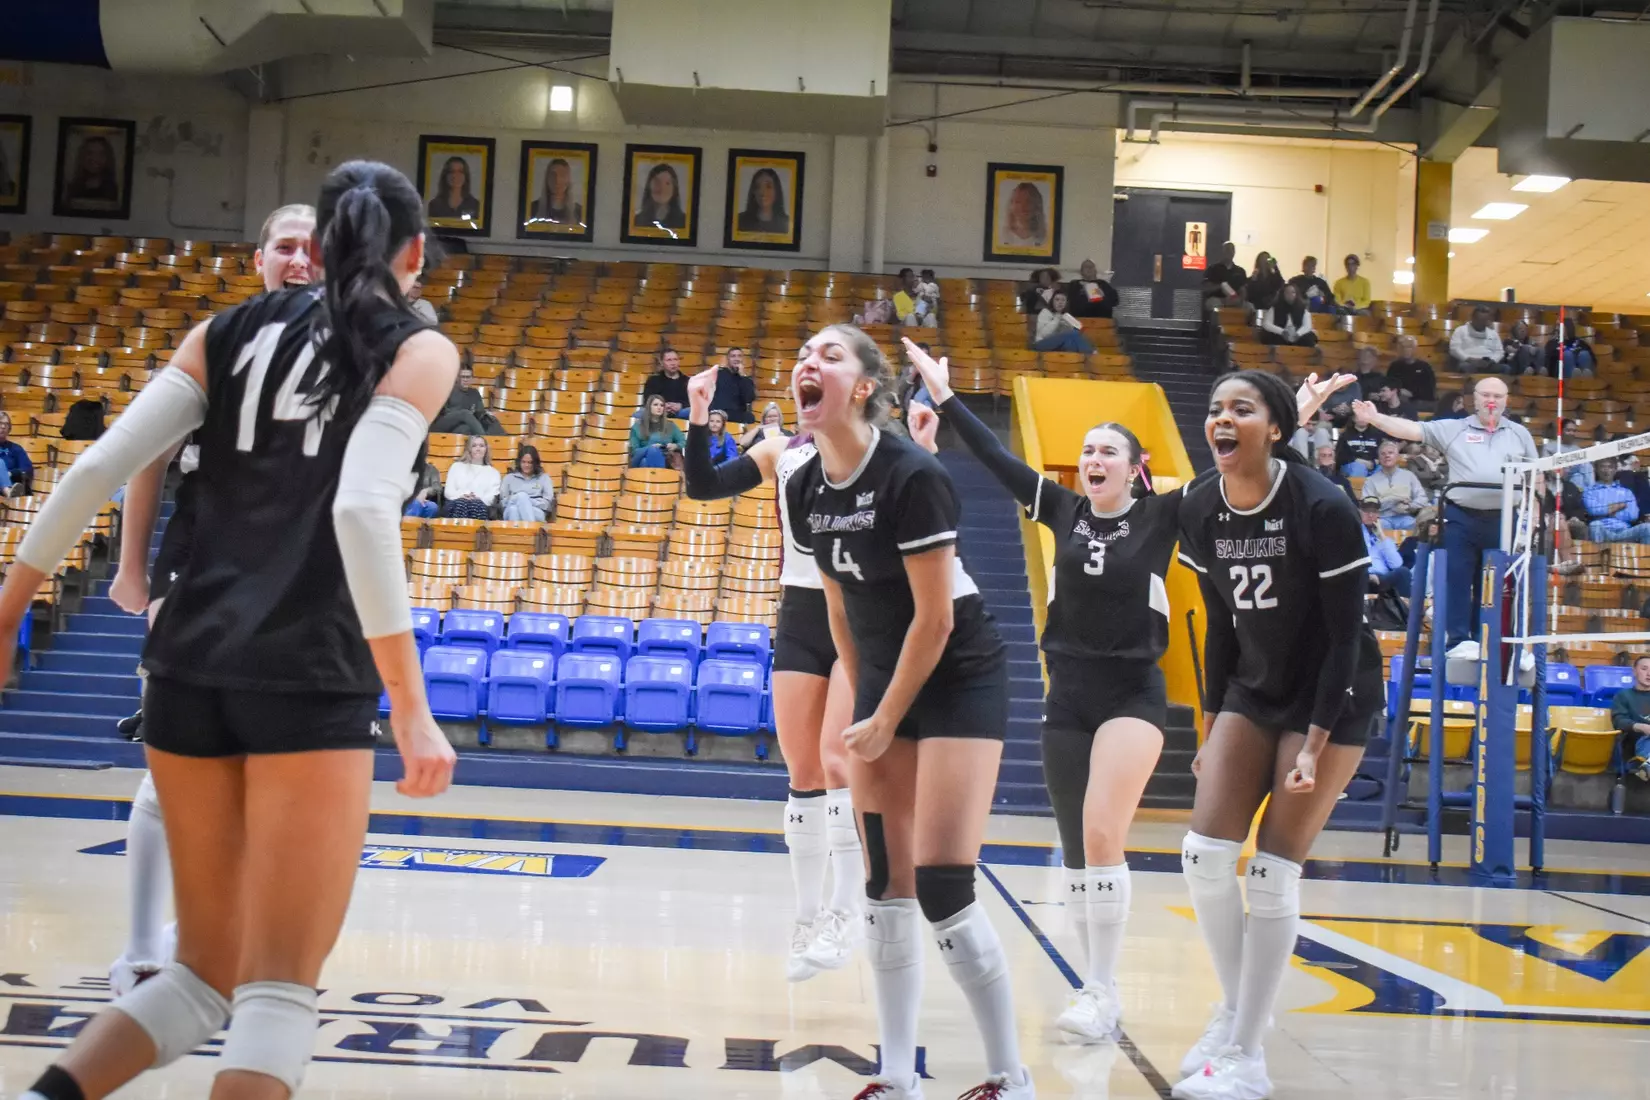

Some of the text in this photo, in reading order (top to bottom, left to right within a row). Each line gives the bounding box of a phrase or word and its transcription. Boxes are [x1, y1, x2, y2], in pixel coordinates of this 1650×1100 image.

[232, 322, 341, 457] 14
[831, 537, 865, 581] 4
[1083, 540, 1106, 575] 3
[1215, 536, 1286, 559] SALUKIS
[1229, 564, 1278, 609] 22
